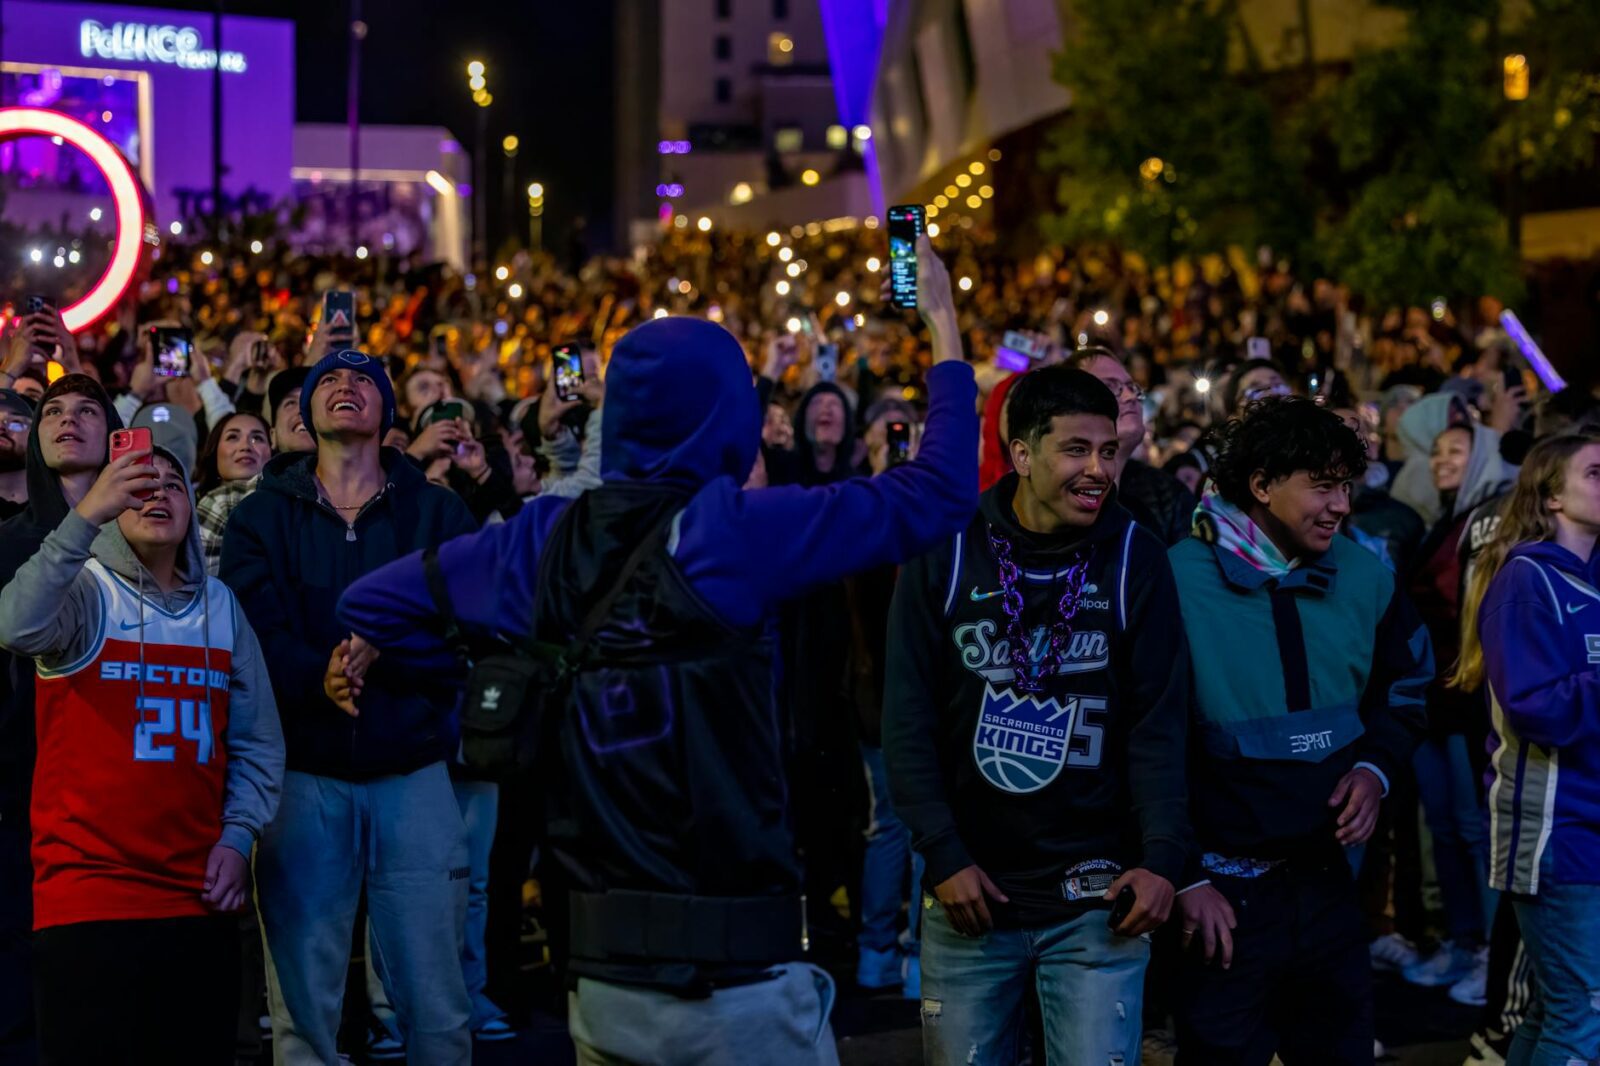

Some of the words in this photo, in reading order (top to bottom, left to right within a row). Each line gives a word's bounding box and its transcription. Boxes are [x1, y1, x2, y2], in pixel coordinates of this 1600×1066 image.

[1075, 598, 1110, 610] alpad
[952, 617, 1110, 671] Satwn
[133, 696, 213, 765] 24
[984, 713, 1064, 738] SACRAMENTO
[977, 725, 1065, 761] KINGS
[1289, 730, 1333, 753] ESPRIT
[1065, 858, 1122, 876] SACRAMENTO
[1079, 863, 1108, 873] PROUD
